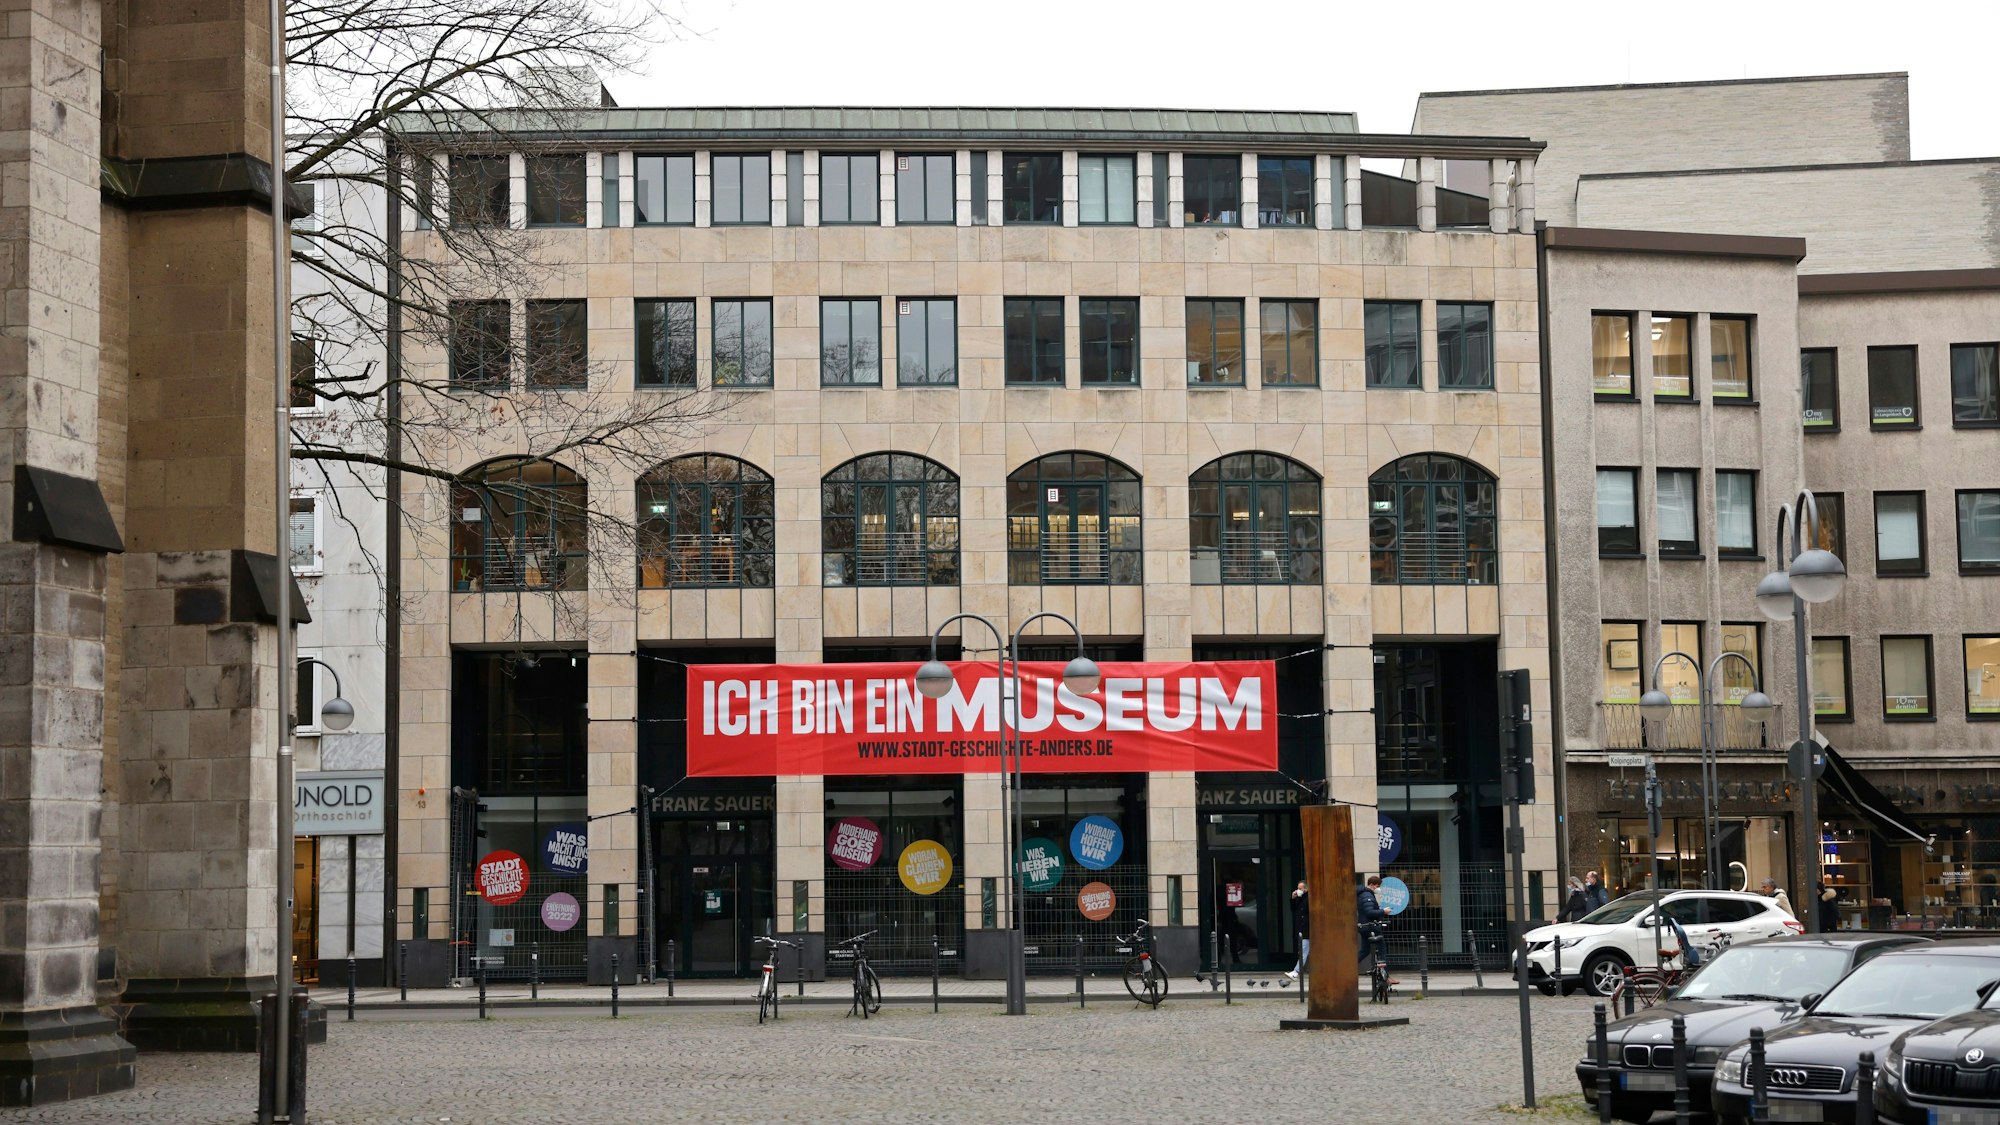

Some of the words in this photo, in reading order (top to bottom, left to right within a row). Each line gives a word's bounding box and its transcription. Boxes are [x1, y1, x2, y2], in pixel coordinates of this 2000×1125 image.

[703, 680, 778, 736] ICH
[792, 679, 853, 734] BIN
[866, 678, 924, 733] EIN
[936, 676, 1262, 733] MUSEUM
[1610, 757, 1642, 765] Kolpingplatz
[652, 796, 710, 812] FRANZ
[714, 796, 775, 811] SAUER
[1239, 789, 1298, 804] SAUER
[556, 831, 587, 847] WAS
[838, 823, 878, 843] MODEHAUS
[1085, 822, 1117, 841] WORAUF
[547, 841, 574, 856] MACHT
[574, 846, 588, 859] UNS
[836, 834, 874, 853] GOES
[1080, 833, 1113, 852] HOFFEN
[552, 853, 582, 869] ANGST
[832, 844, 872, 864] MUSEUM
[907, 848, 938, 863] WORAN
[1026, 847, 1045, 860] WAS
[1081, 845, 1107, 862] WIR
[481, 858, 520, 875] STADT
[905, 859, 945, 876] GLAUBEN
[481, 869, 523, 886] GESCHICHTE
[914, 871, 942, 885] WIR
[1030, 869, 1049, 882] WIR
[486, 880, 521, 897] ANDERS
[1085, 900, 1110, 911] 2022
[547, 911, 573, 920] 2022
